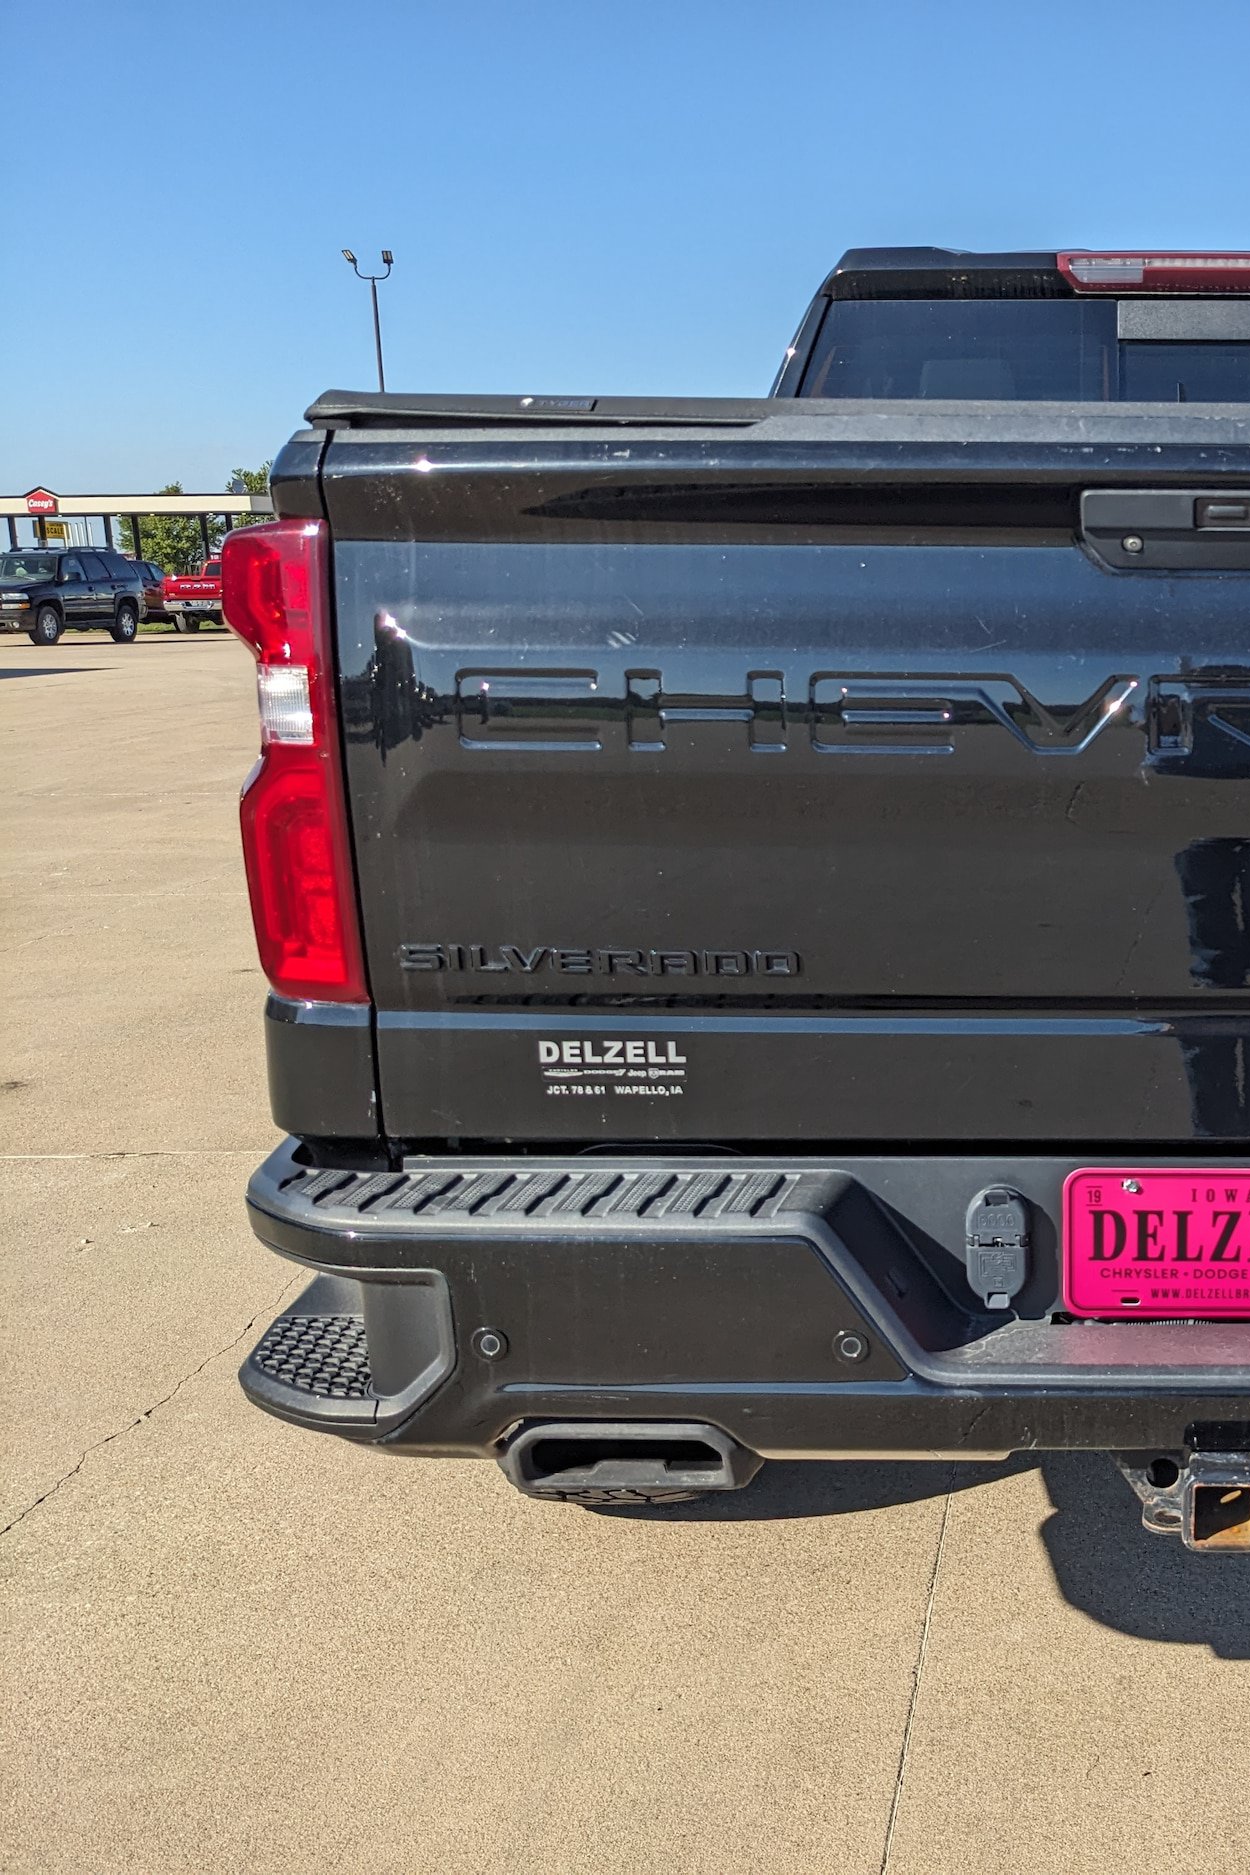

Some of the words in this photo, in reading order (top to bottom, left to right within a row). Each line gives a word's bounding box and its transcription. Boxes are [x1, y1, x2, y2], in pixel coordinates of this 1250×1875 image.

[29, 499, 53, 508] Casey's
[399, 943, 802, 976] SILVERADO
[538, 1041, 687, 1063] DELZELL
[627, 1069, 646, 1077] Jeep
[547, 1086, 569, 1095] JCT.
[571, 1086, 583, 1095] 78
[585, 1086, 593, 1095] &
[594, 1086, 605, 1095] 61
[614, 1086, 669, 1096] WAPELLO,
[670, 1086, 683, 1094] IA
[1087, 1189, 1102, 1203] 19
[1100, 1267, 1179, 1280] CHRYSLER
[1193, 1268, 1248, 1280] DODGE
